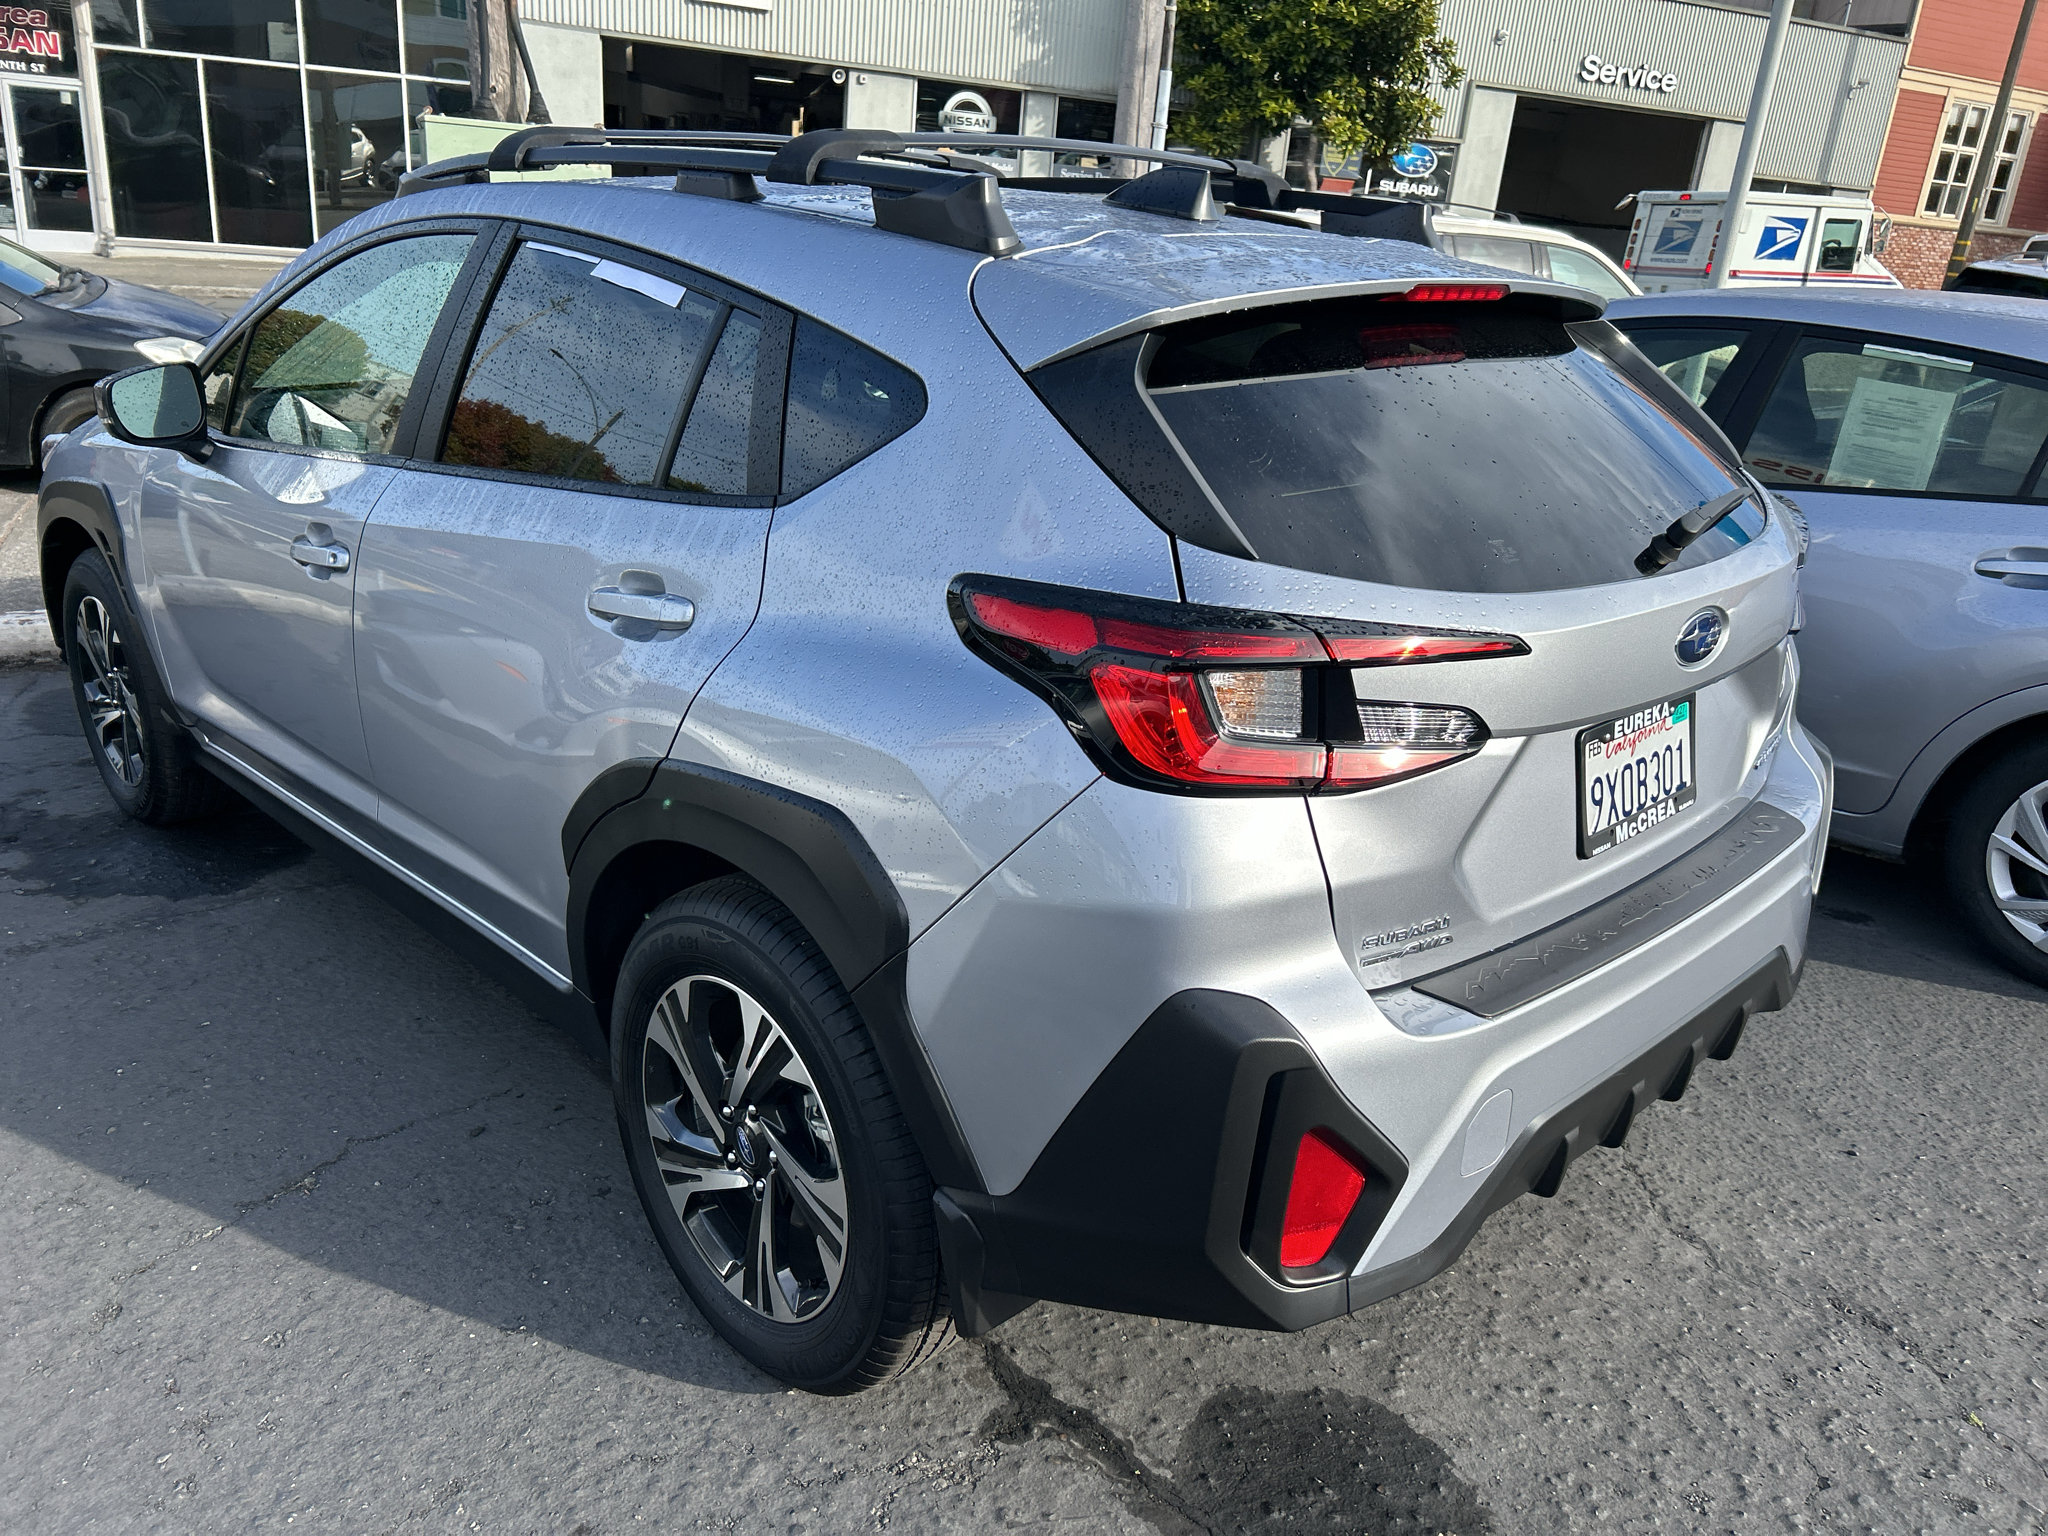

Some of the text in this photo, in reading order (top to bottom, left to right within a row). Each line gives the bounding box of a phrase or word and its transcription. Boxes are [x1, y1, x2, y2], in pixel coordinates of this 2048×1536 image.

[30, 62, 46, 73] ST
[1581, 54, 1678, 93] Service
[943, 113, 991, 129] NISSAN
[1379, 179, 1440, 197] SUBARU
[1605, 717, 1674, 760] California
[1614, 701, 1670, 740] EUREKA
[1616, 798, 1676, 845] McCREA
[1592, 842, 1612, 857] NISSAN
[1361, 912, 1450, 950] SUBARU
